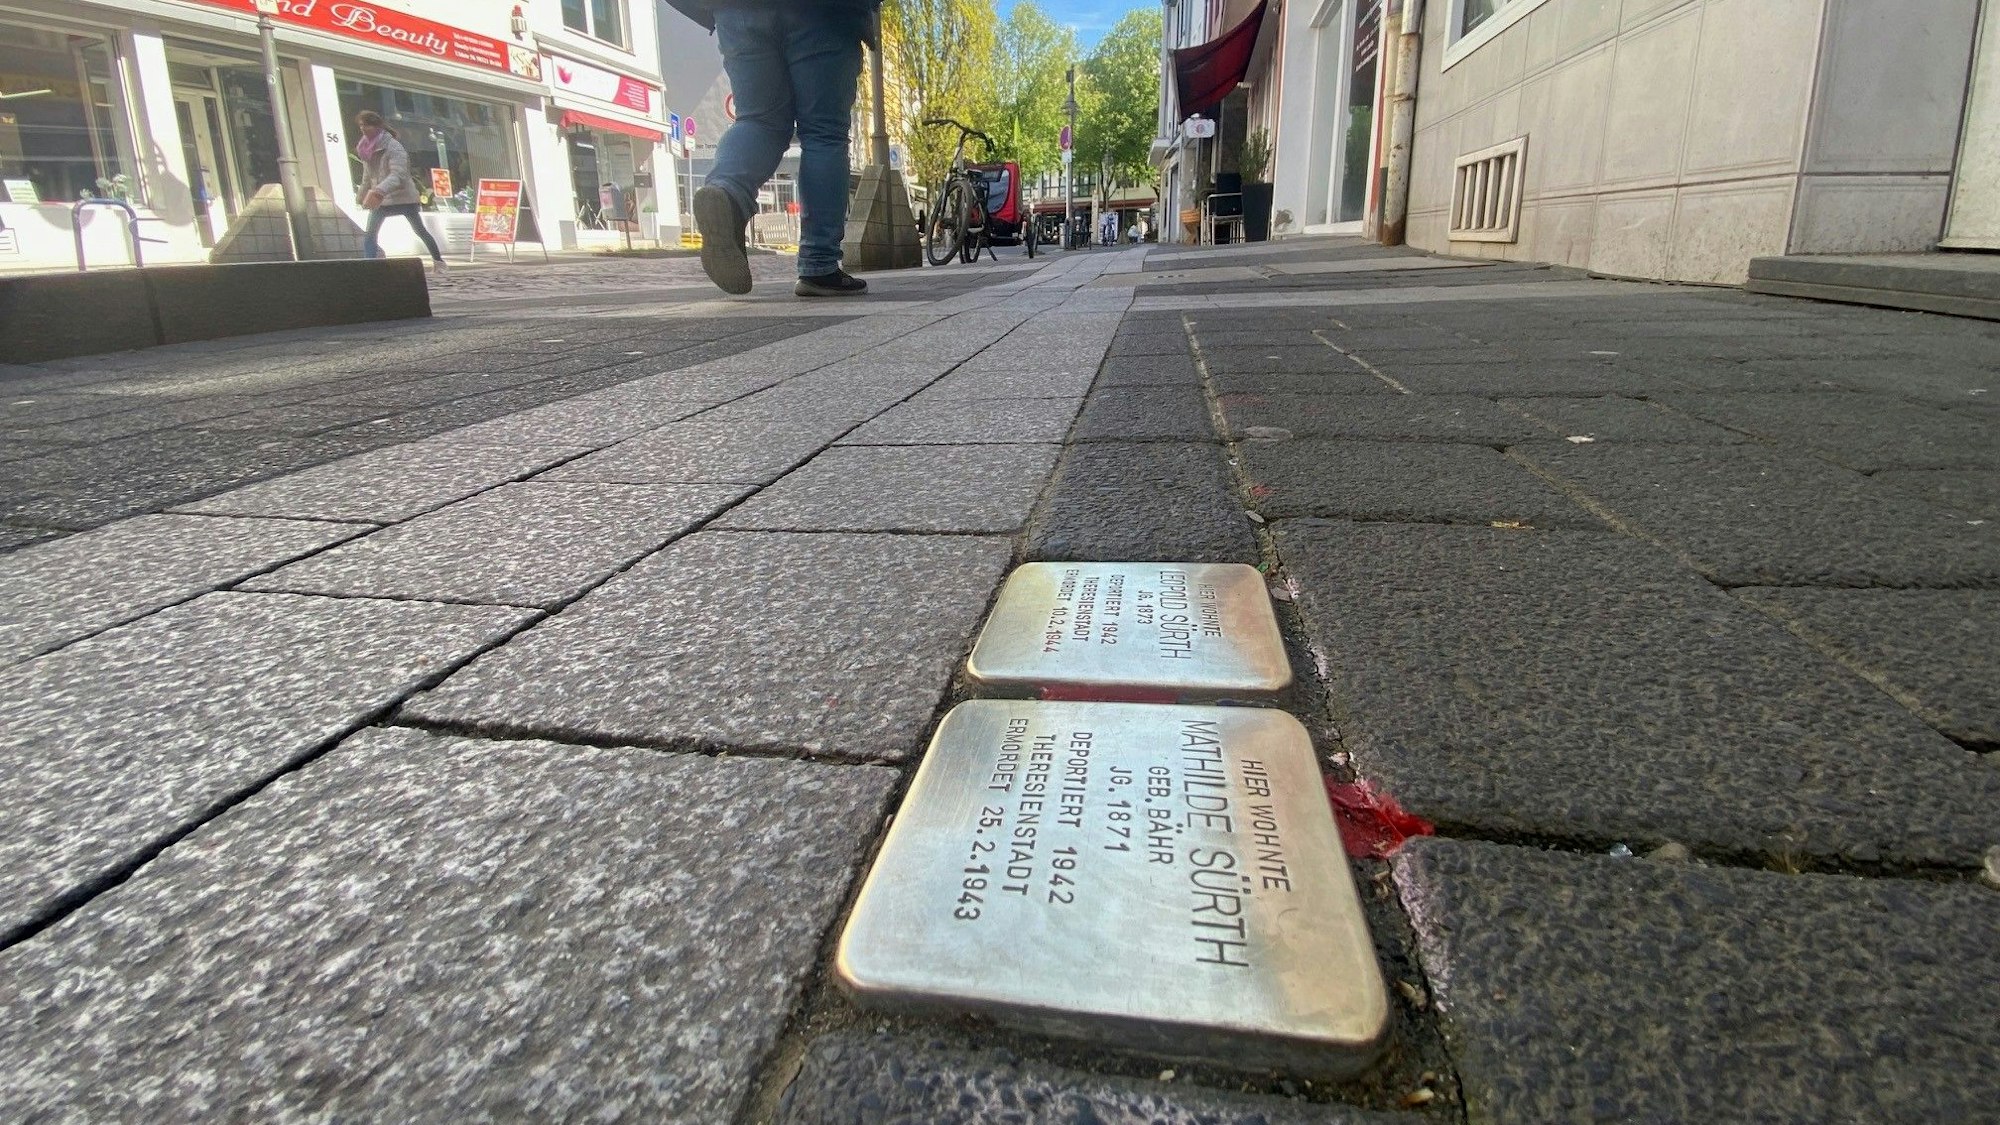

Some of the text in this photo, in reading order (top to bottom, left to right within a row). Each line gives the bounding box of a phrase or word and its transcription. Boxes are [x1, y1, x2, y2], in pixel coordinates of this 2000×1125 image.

[329, 2, 449, 55] Beauty
[326, 132, 339, 143] 56
[1042, 569, 1080, 653] ERMORDET 10.2.1944
[1072, 576, 1100, 642] THERESIENSTADT
[1100, 574, 1125, 645] DEPORTIERT 1942
[1136, 590, 1154, 625] JG. 1873
[1159, 571, 1197, 659] LEOPOLD SÜRTH
[1198, 583, 1222, 638] HIER WOHNTE
[988, 718, 1029, 792] ERMORDET
[1001, 734, 1056, 896] THERESIENSTADT
[1048, 731, 1093, 905] DEPORTIERT 1942
[1103, 765, 1133, 853] JG. 1871
[1144, 766, 1184, 865] GEB. BÄHR
[1181, 720, 1252, 967] MATHILDE SÜRTH
[1240, 758, 1292, 893] HIER WOHNTE
